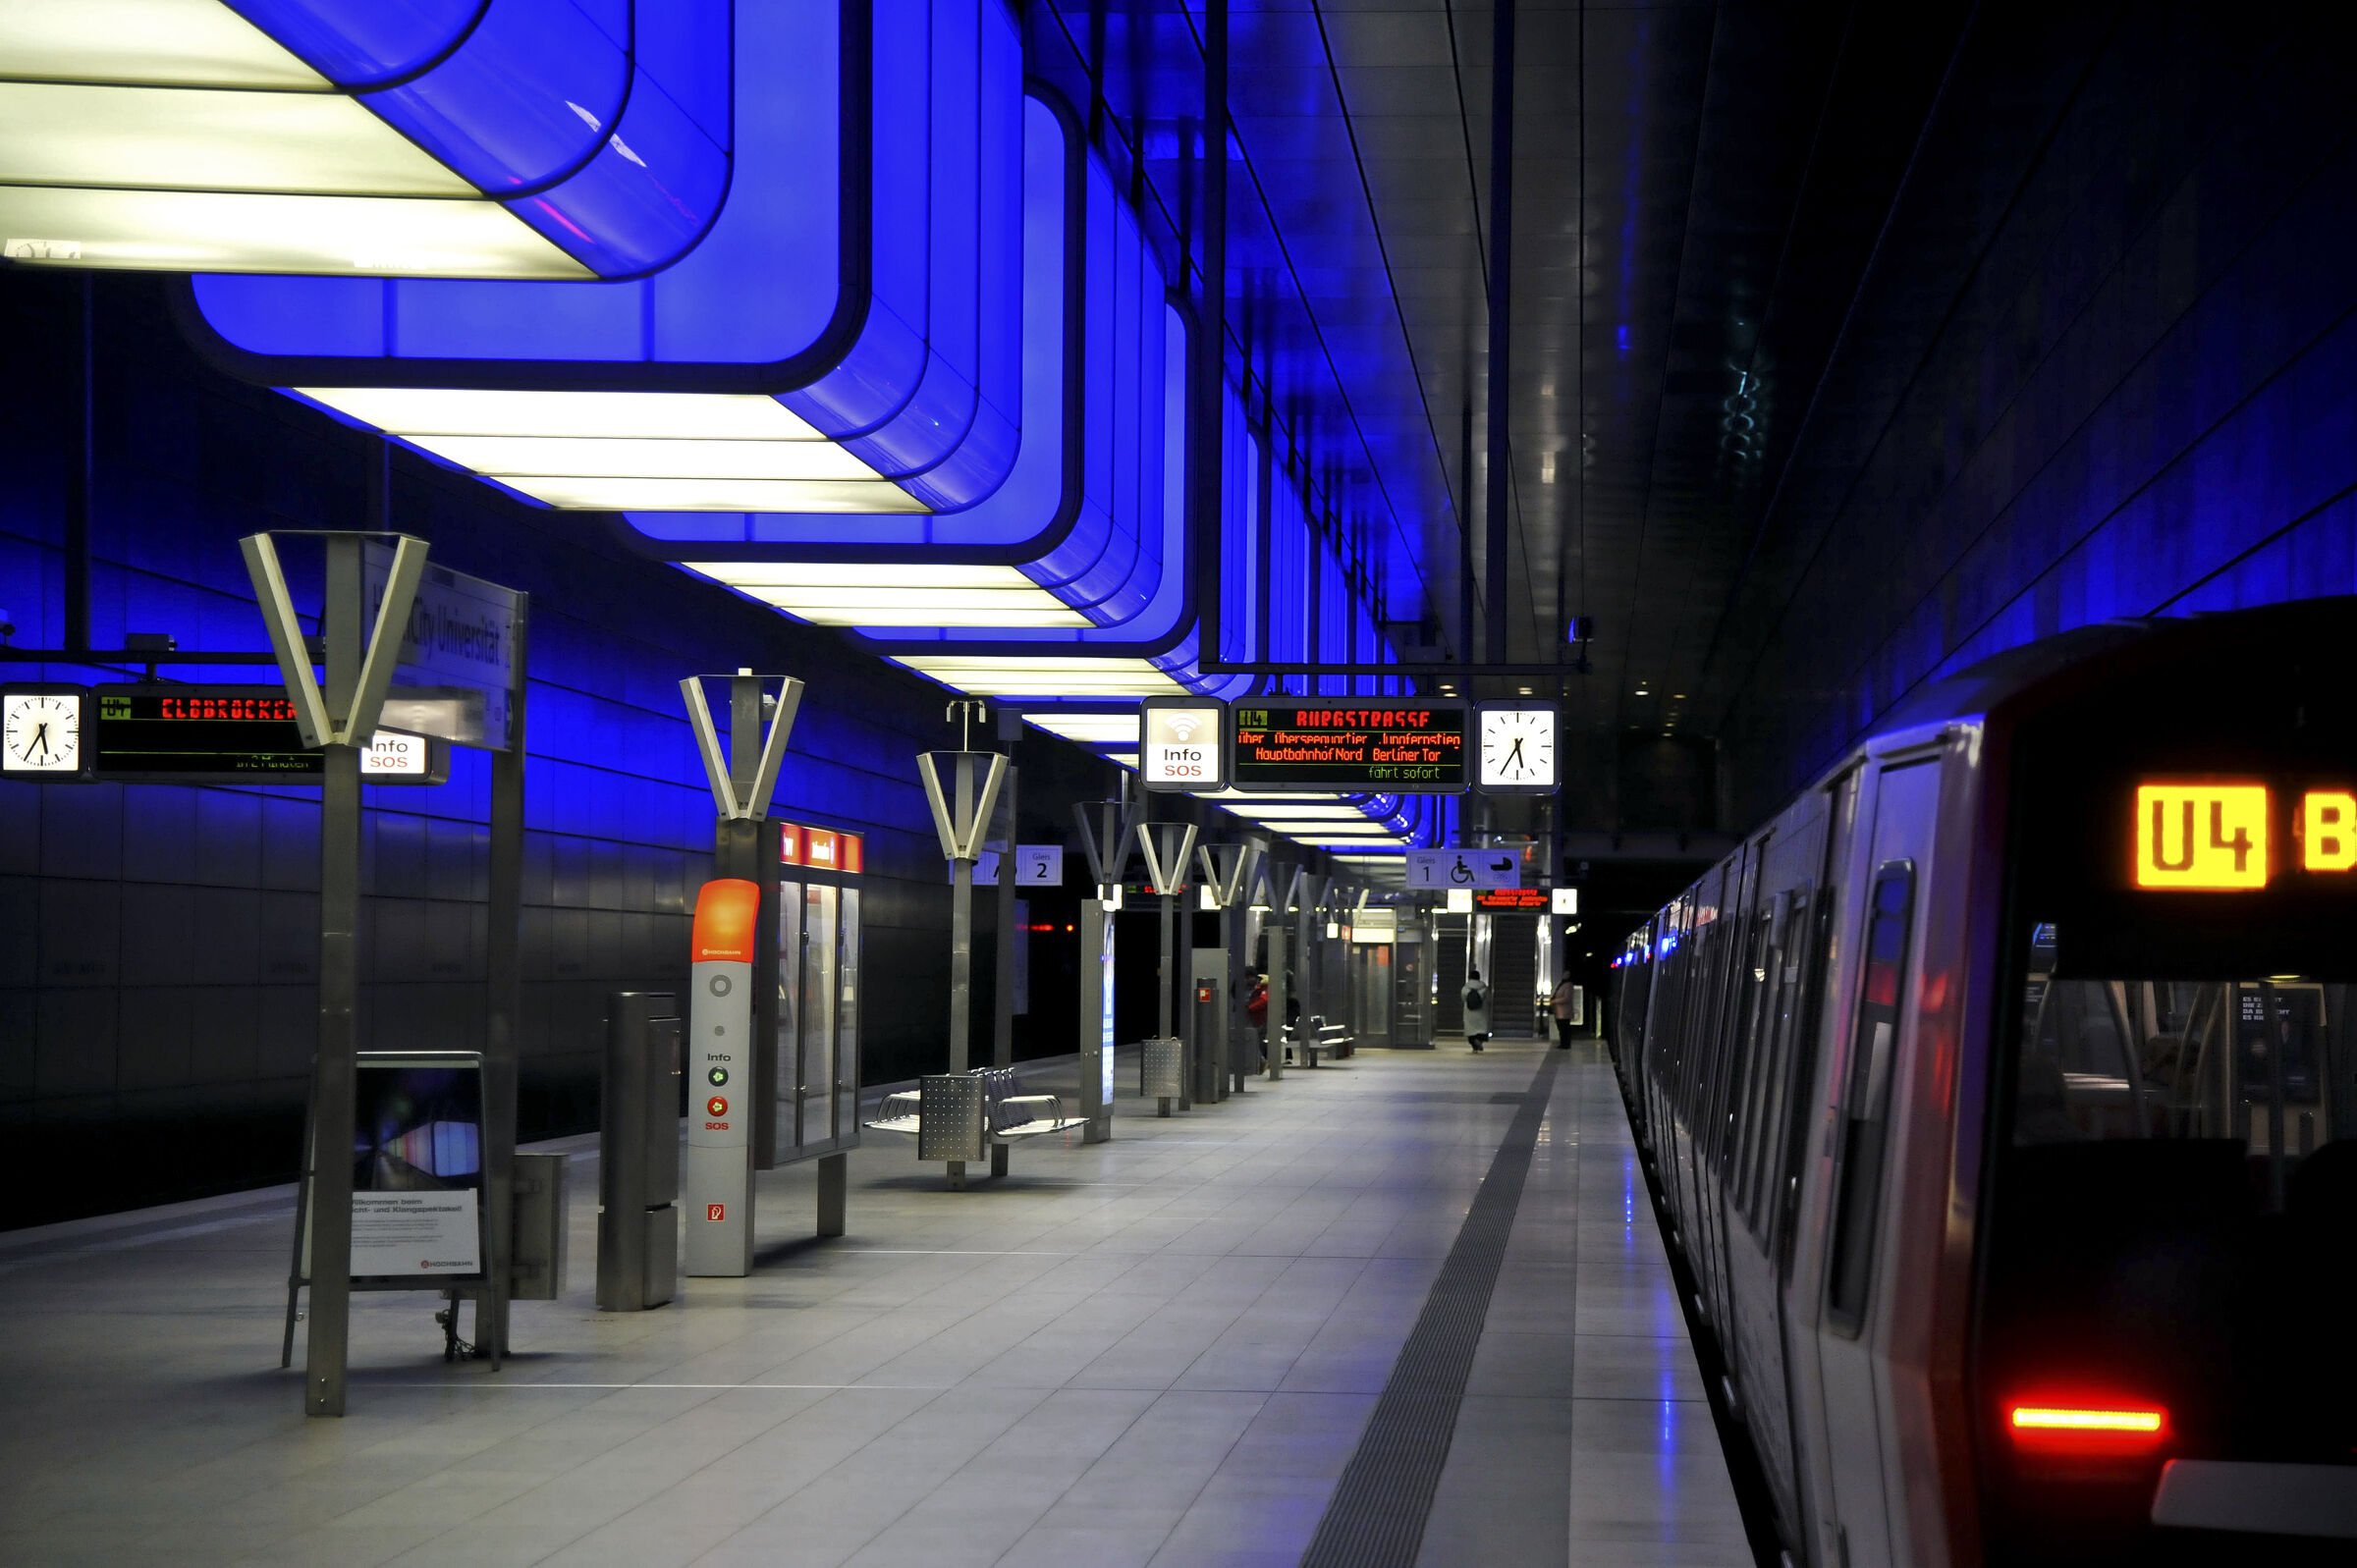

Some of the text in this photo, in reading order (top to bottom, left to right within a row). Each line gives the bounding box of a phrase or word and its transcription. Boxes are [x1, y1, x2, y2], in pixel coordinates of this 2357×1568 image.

[1164, 748, 1202, 762] Info
[1255, 747, 1442, 762] Hauptbahnhof Nord Berliner Tor
[369, 756, 409, 768] SOS
[1164, 764, 1203, 777] SOS
[1368, 766, 1441, 780] fährt sofort
[2152, 799, 2254, 873] U4
[1032, 852, 1051, 861] Gleis
[1036, 863, 1047, 878] 2
[1423, 866, 1430, 882] 1
[707, 1053, 732, 1061] Info
[705, 1121, 730, 1130] SOS
